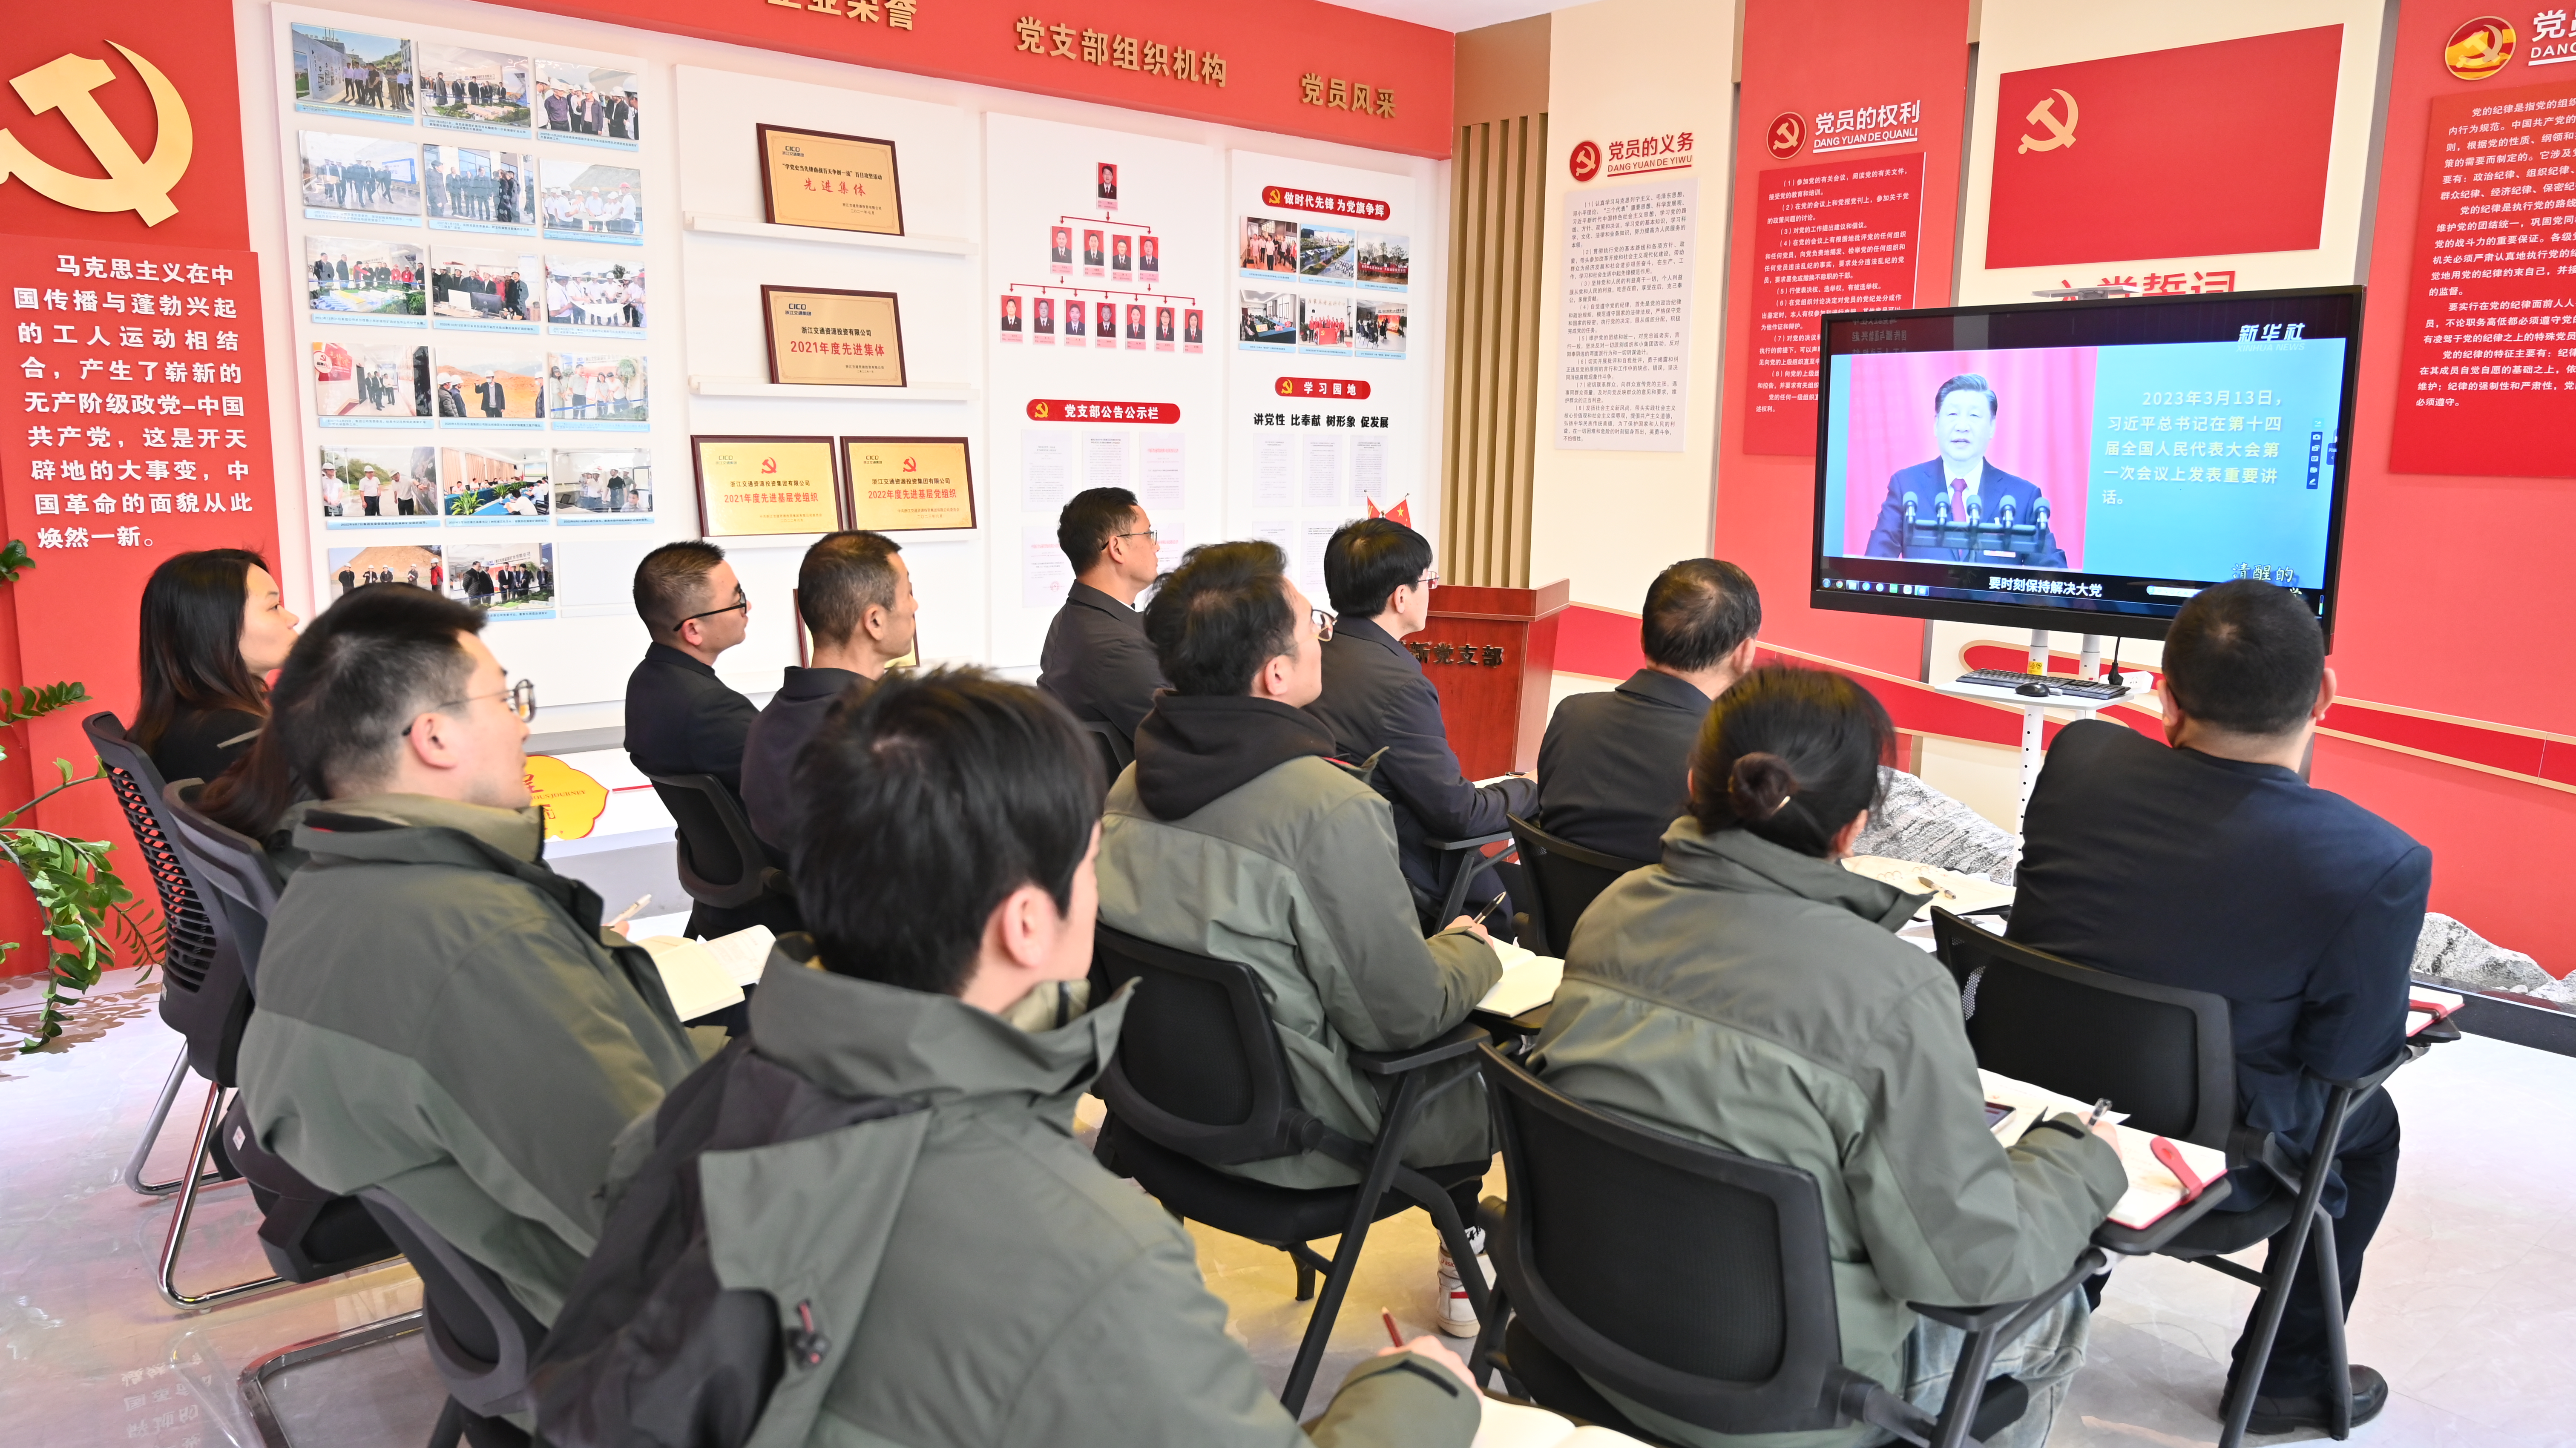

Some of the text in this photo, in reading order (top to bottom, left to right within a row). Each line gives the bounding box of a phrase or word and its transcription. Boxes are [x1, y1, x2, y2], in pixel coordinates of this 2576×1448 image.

[1014, 16, 1228, 88] 党支部组织机构
[1299, 72, 1397, 119] 党员风采
[1815, 100, 1920, 135] 党员的权利
[2449, 114, 2576, 135] 内行为规范。中国共产党的
[1814, 127, 1918, 148] DANG YUAN DE QUANLI
[2446, 132, 2576, 152] 则，根据党的性质、纲领和
[1608, 132, 1694, 162] 党员的义务
[1607, 155, 1693, 172] DANG YUAN DE YIWU
[804, 178, 866, 196] 先进集体
[1768, 189, 1823, 200] 接受党的教育和培训。
[2440, 182, 2576, 201] 群众纪律、经济纪律、保密纪
[1284, 191, 1384, 217] 做时代先锋 为党旗争辉
[2460, 198, 2576, 215] 党的纪律是执行党的路线
[1767, 214, 1816, 224] 的政策问题的讨论。
[2436, 215, 2576, 233] 维护党的团结统一，巩固党同
[2435, 232, 2576, 249] 党的战斗力的重要保证。各级
[56, 255, 233, 285] 马克思主义在中
[2429, 287, 2463, 296] 的监督。
[14, 288, 237, 319] 国传播与蓬勃兴起
[2448, 299, 2576, 311] 要实行在党的纪律面前人人
[18, 323, 239, 352] 的工人运动相结
[801, 327, 871, 336] 浙江交通资源投资有限公司
[2237, 322, 2305, 342] 新华社
[2424, 331, 2576, 344] 有凌驾于党的纪律之上的特殊党员
[791, 341, 885, 356] 2021年度先进集体
[2236, 342, 2305, 352] XINHUA NEWS
[21, 357, 242, 384] 合，产生了崭新的
[1304, 382, 1356, 396] 学习园地
[2418, 381, 2576, 391] 维护；纪律的强制性和严肃性，党
[2142, 390, 2283, 406] 2023年3月13日，
[2416, 398, 2459, 406] 必须遵守。
[1064, 404, 1159, 420] 党支部公告公示栏
[1254, 413, 1389, 428] 讲党性 比奉献 树形象 促发展
[2107, 416, 2281, 432] 习近平总书记在第十四
[28, 427, 247, 449] 共产党，这是开天
[2105, 442, 2280, 458] 届全国人民代表大会第
[31, 460, 249, 482] 辟地的大事变，中
[2104, 466, 2277, 484] 一次会议上发表重要讲
[724, 492, 819, 503] 2021年度先进基层党组织
[868, 489, 957, 499] 2022年度先进基层党组织
[2102, 490, 2123, 505] 话。
[35, 493, 252, 515] 国革命的面貌从此
[37, 527, 153, 550] 焕然一新。
[2231, 562, 2294, 583] 清醒的
[1989, 576, 2102, 598] 要时刻保持解决大党
[1401, 640, 1504, 668] 新党支部
[551, 790, 586, 799] JOURNEY
